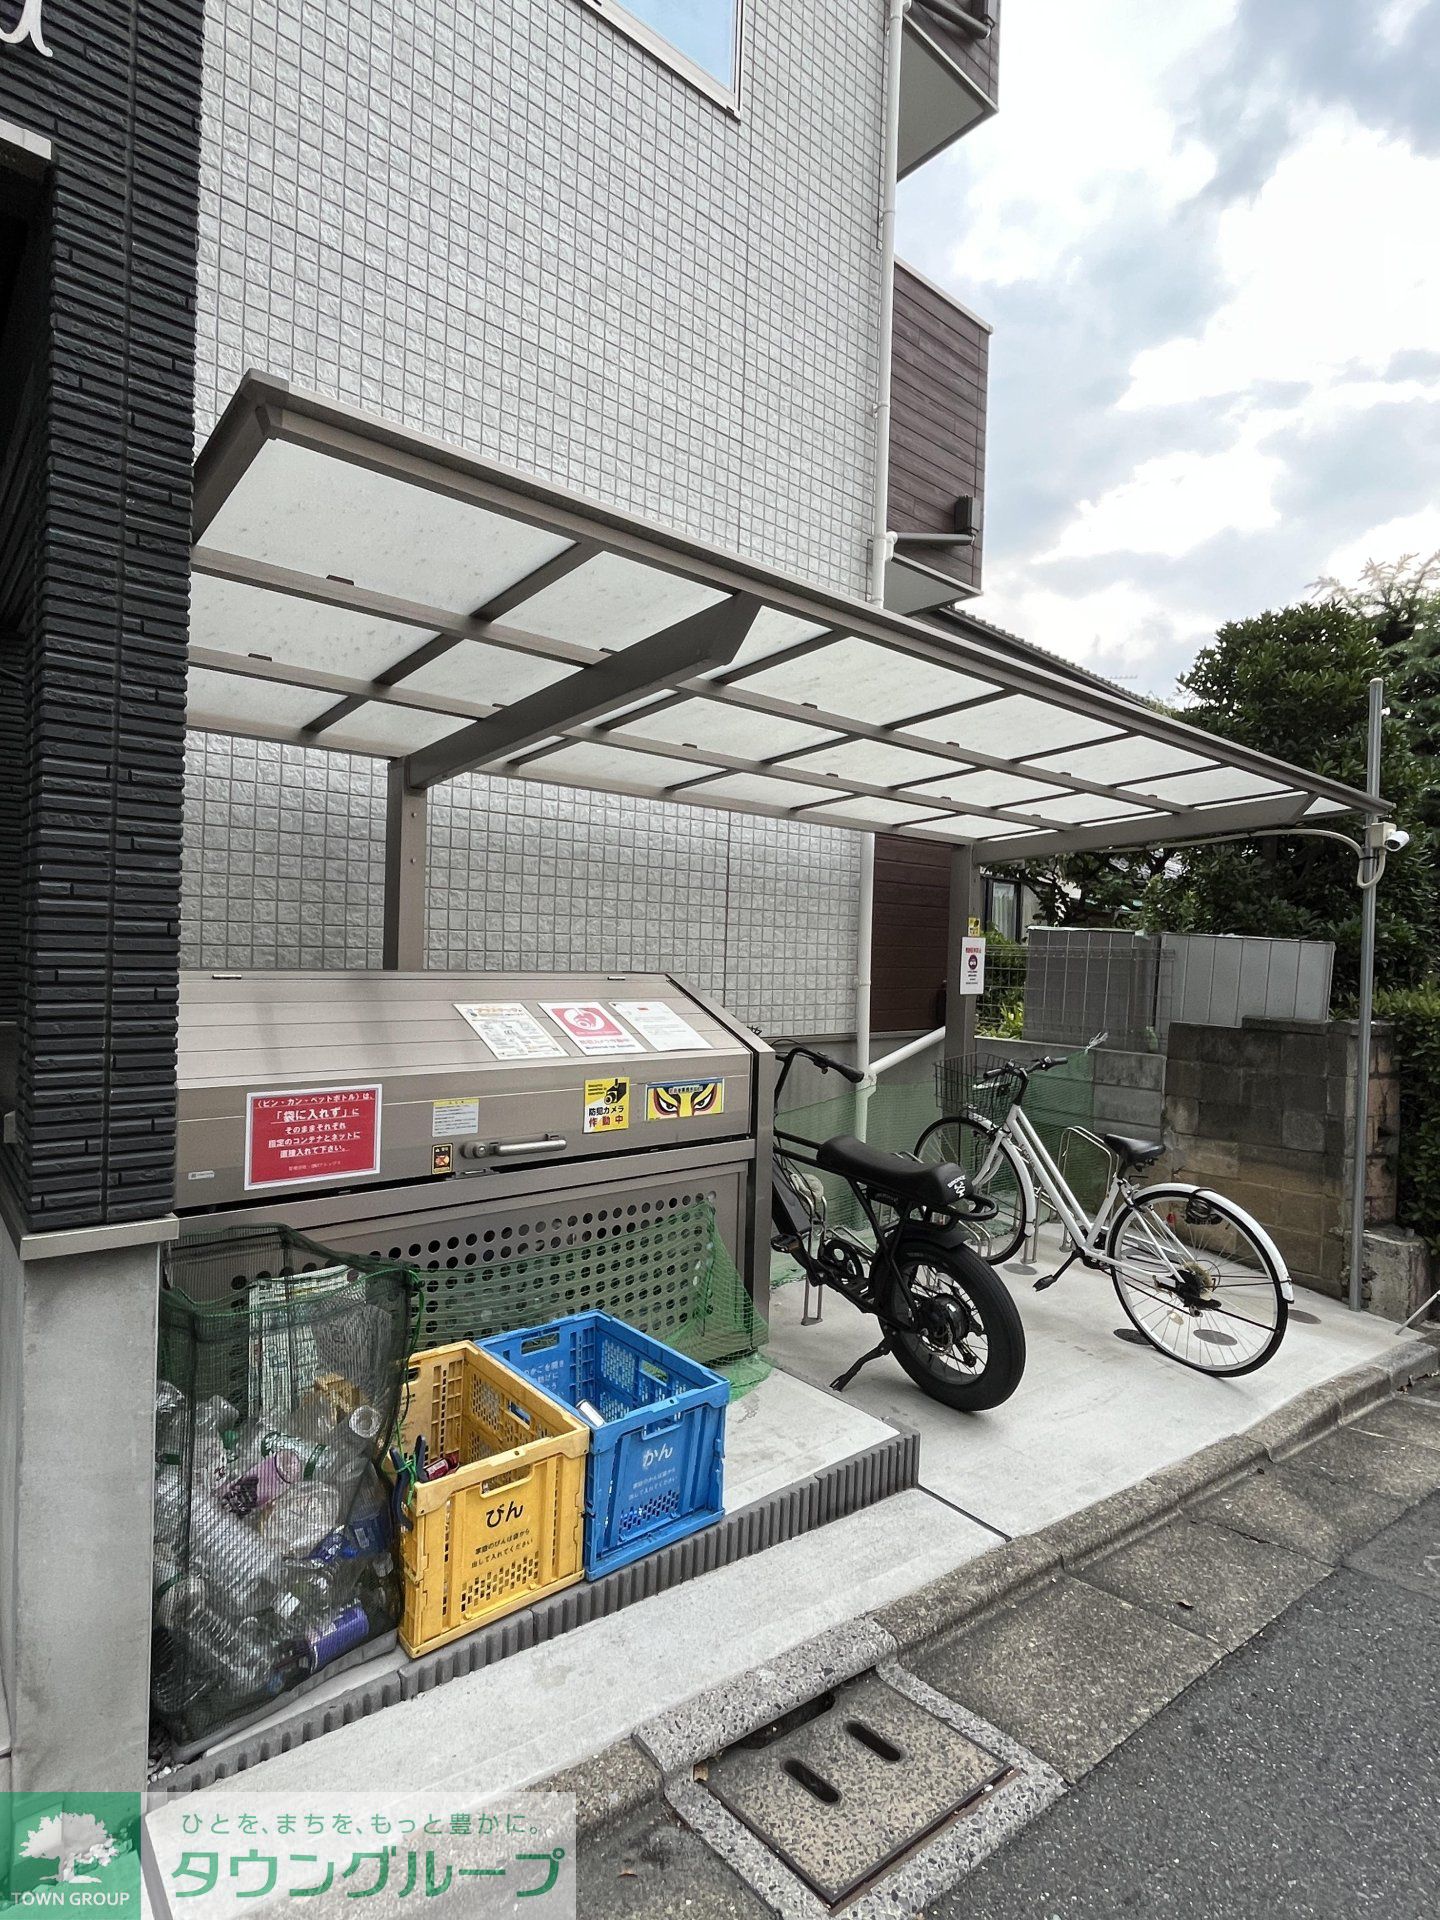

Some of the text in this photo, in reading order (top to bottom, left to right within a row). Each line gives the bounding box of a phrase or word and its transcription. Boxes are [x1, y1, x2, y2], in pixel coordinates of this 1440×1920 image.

[276, 1107, 359, 1122] 「袋に入れず」に
[588, 1105, 625, 1116] 防犯カメラ
[285, 1121, 346, 1135] そのままそれぞれ
[268, 1131, 360, 1149] 指定のコンテナとネットに
[279, 1144, 345, 1159] 直接入れて下さい。
[642, 1443, 673, 1469] かん
[486, 1500, 524, 1528] びん
[471, 1538, 533, 1568] 出して入れてください
